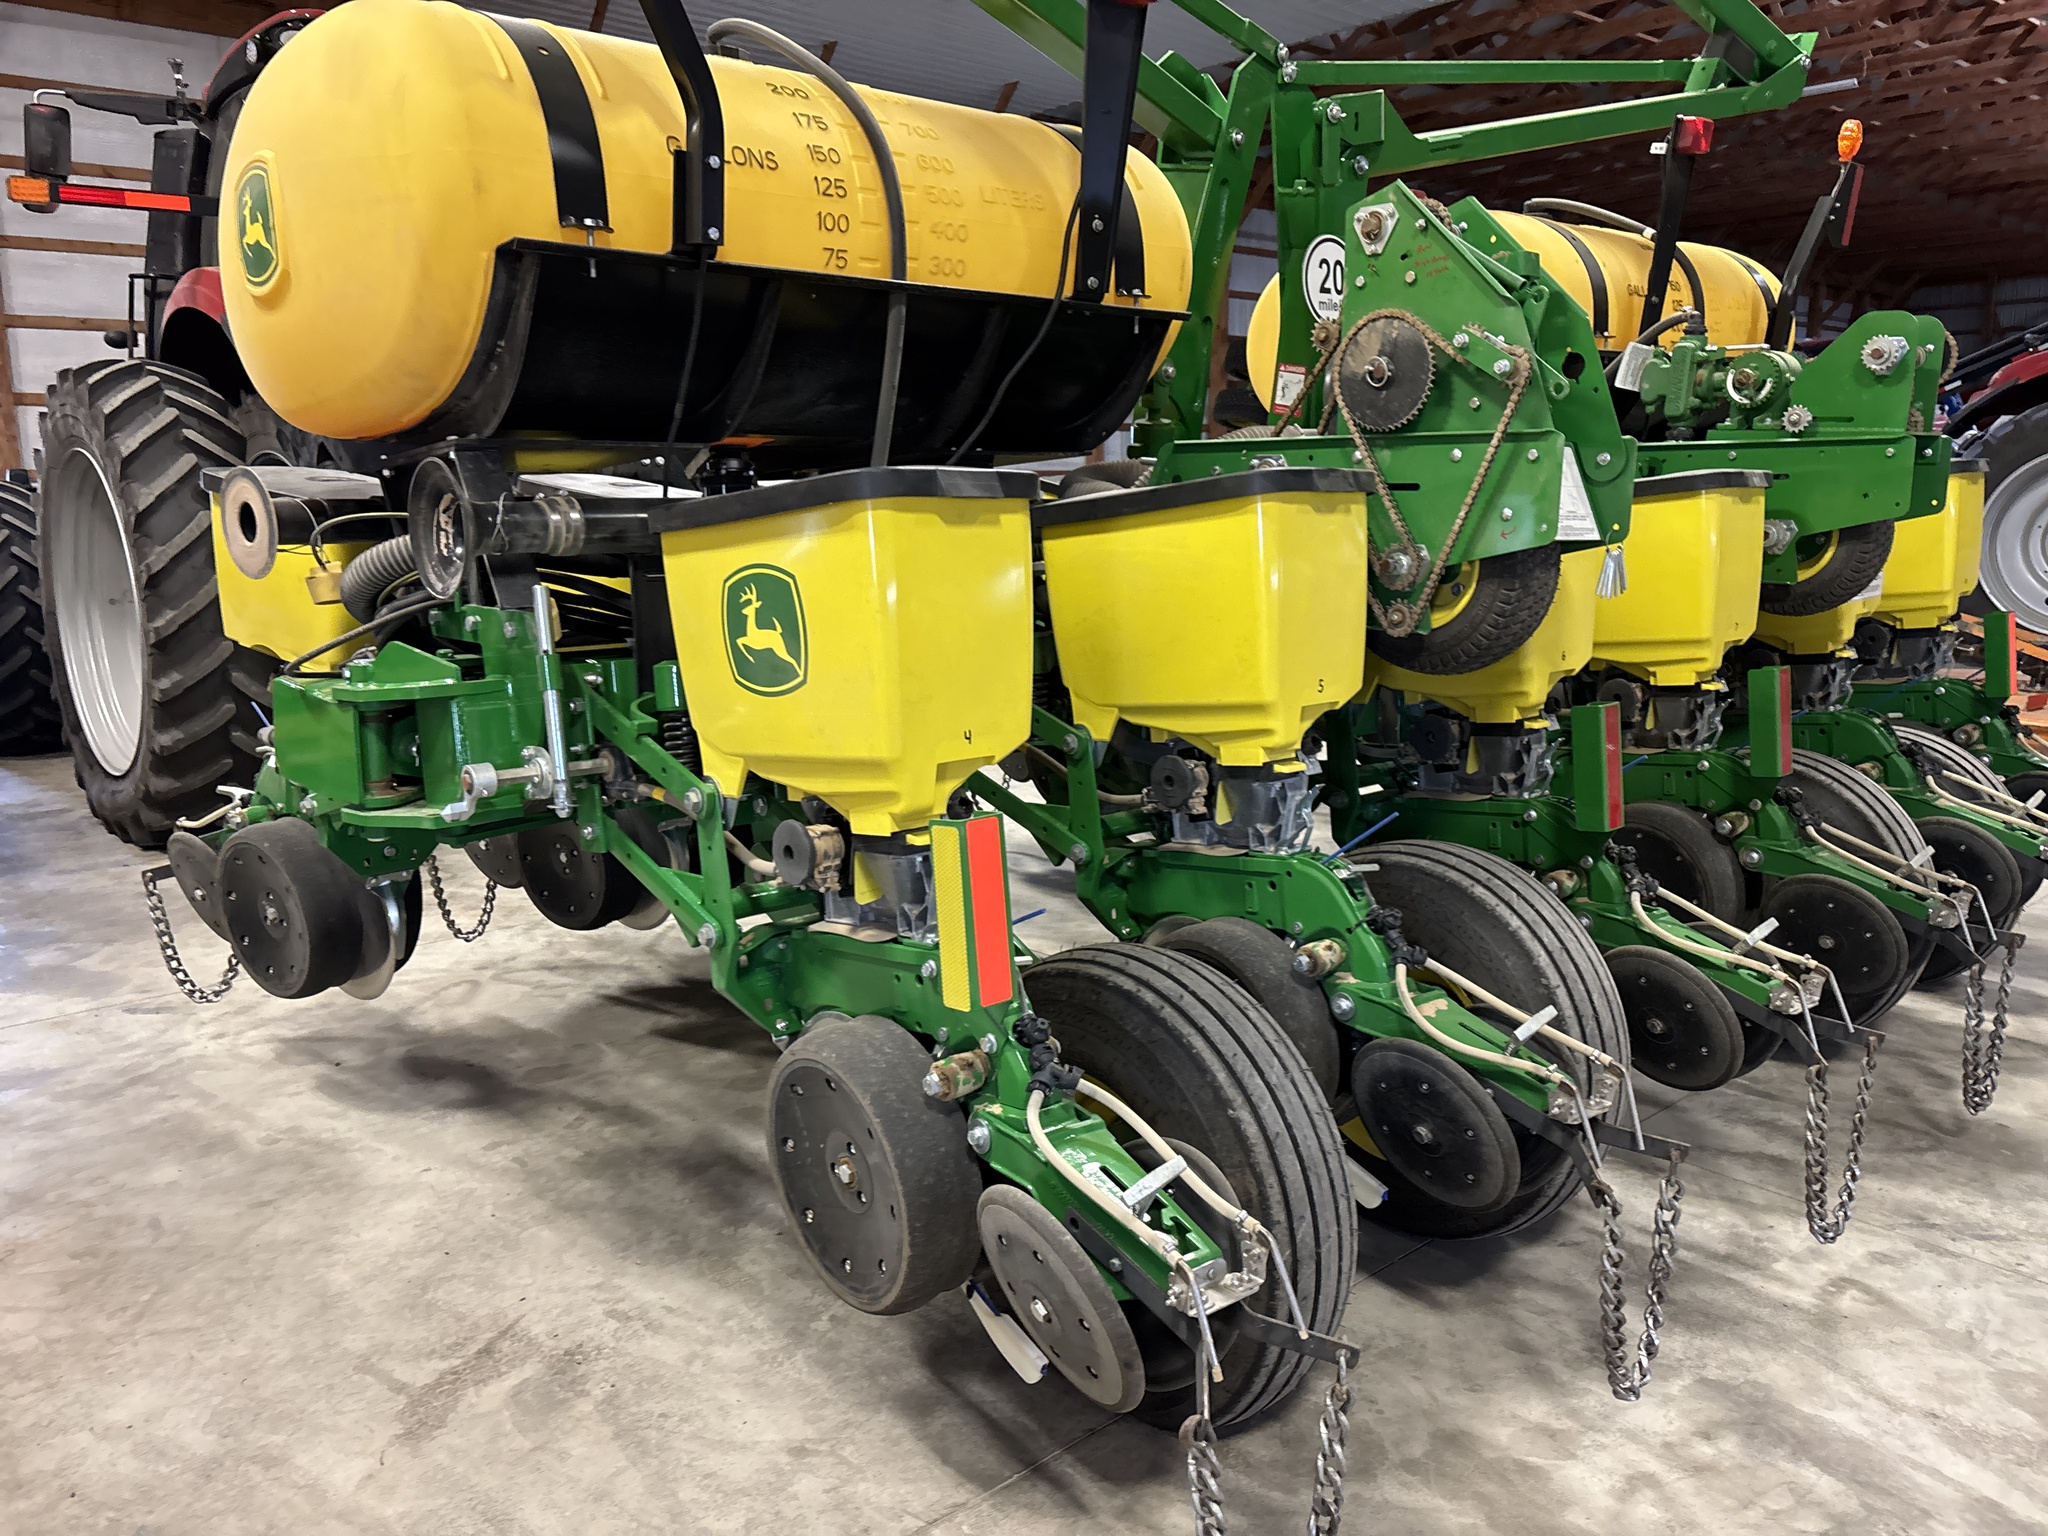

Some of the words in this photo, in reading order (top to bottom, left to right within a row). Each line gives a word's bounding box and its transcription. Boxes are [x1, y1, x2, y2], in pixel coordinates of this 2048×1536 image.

[765, 82, 810, 100] 200
[792, 111, 829, 132] 175
[898, 121, 940, 140] 700
[665, 135, 779, 171] GONS
[806, 143, 841, 165] 150
[915, 153, 955, 174] 600
[813, 175, 848, 199] 125
[925, 184, 964, 208] 500
[978, 183, 1045, 212] LITERS
[817, 210, 850, 234] 100
[929, 220, 969, 243] 400
[822, 247, 849, 270] 75
[928, 255, 967, 279] 300
[1318, 257, 1344, 296] 20
[1318, 298, 1341, 312] mile
[1317, 678, 1325, 694] 5
[963, 729, 972, 745] 4
